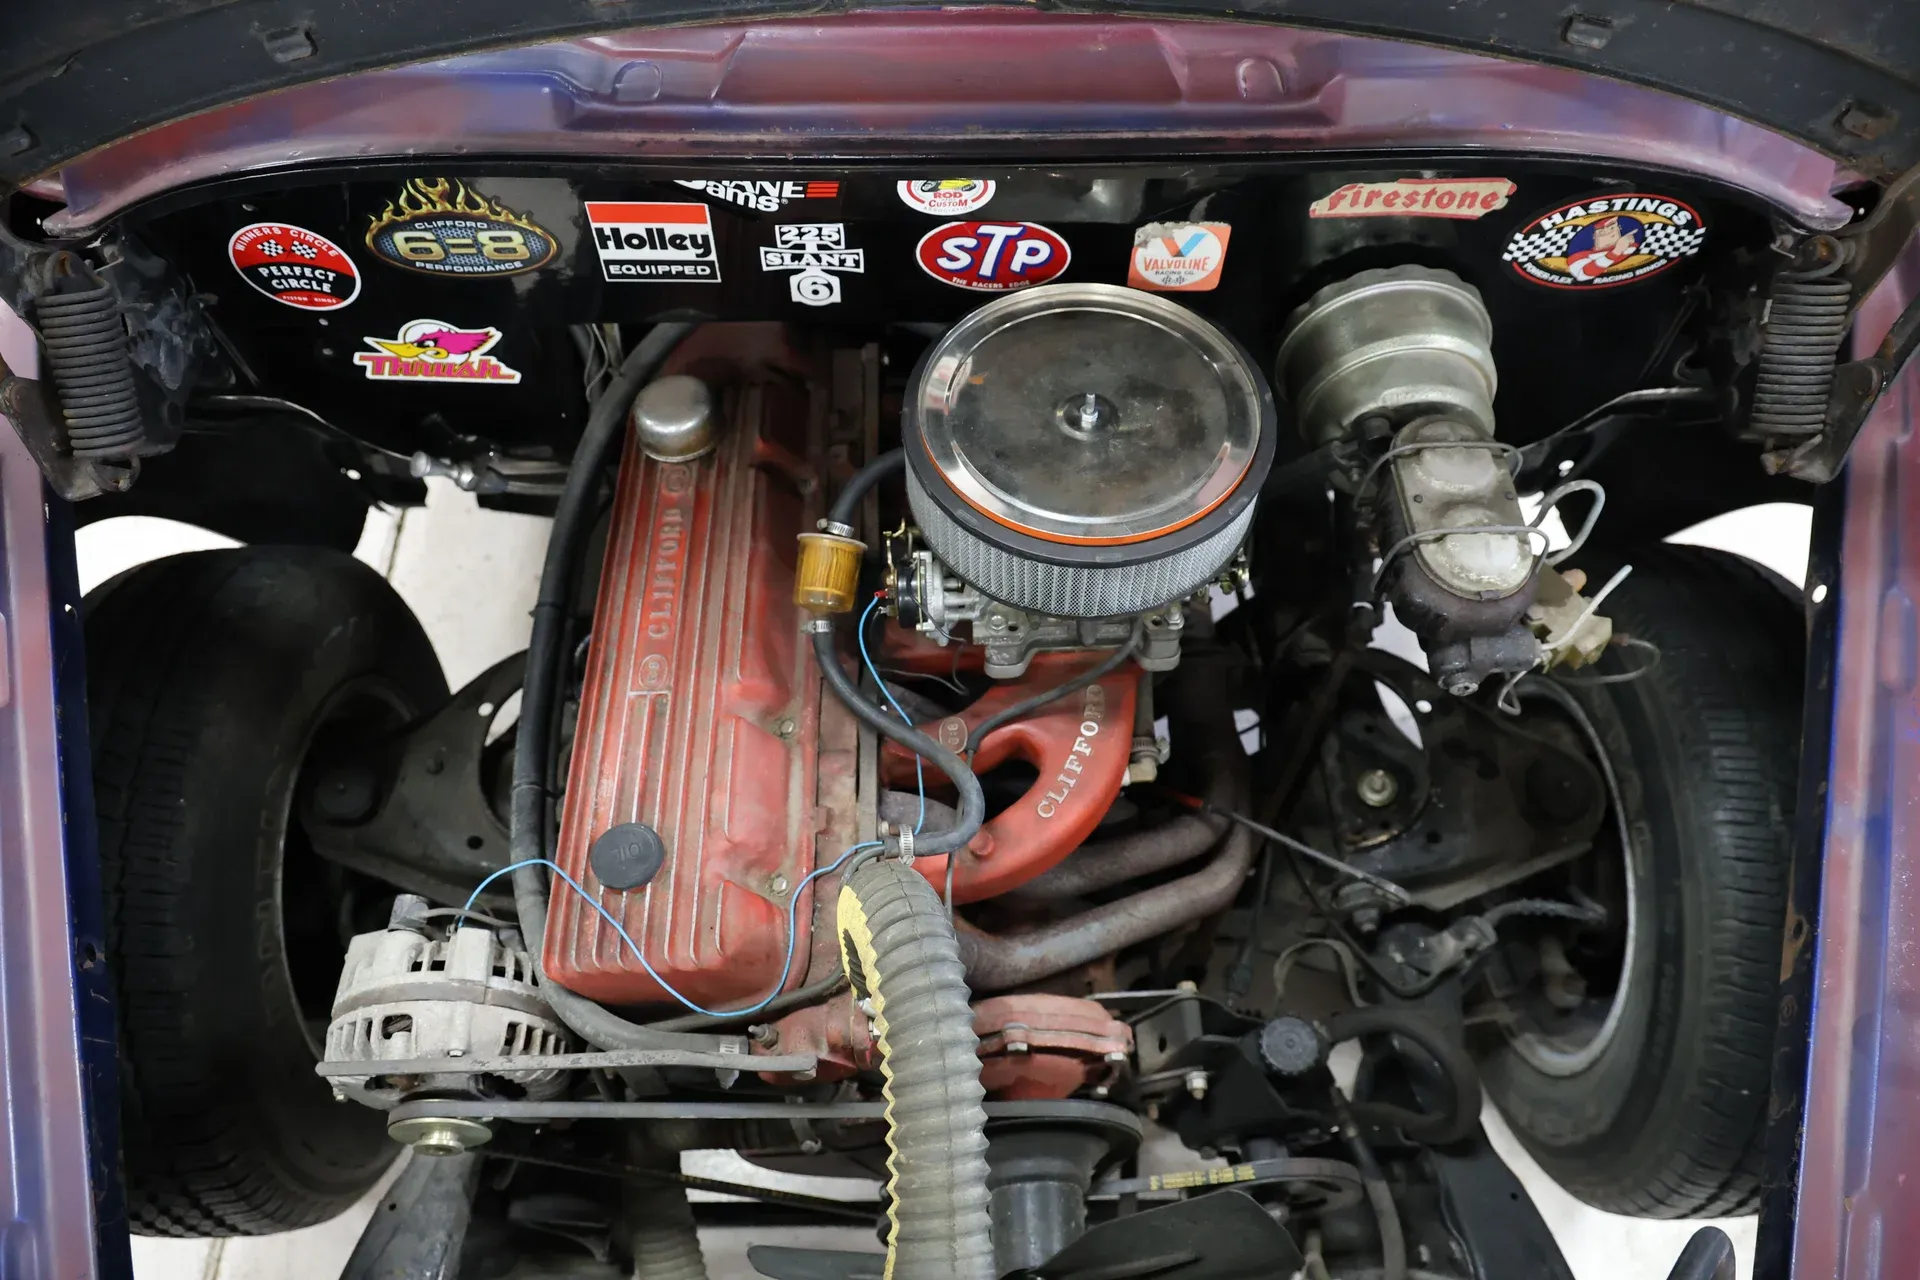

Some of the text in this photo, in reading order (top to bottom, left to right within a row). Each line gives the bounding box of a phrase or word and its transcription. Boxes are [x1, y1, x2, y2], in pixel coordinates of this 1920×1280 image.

[933, 191, 963, 199] ROD
[1328, 184, 1500, 211] Firestone
[1540, 198, 1692, 231] HASTINGS
[415, 220, 488, 229] CLIFFORD
[234, 226, 339, 257] WINNERS CIRCLE
[780, 226, 840, 241] 225
[594, 227, 712, 258] Holley
[936, 224, 1052, 278] STP
[415, 261, 523, 273] PERFORMANCE
[765, 252, 859, 267] SLANT
[1143, 256, 1208, 272] VALVOLINE
[258, 265, 336, 282] PERFECT
[608, 264, 711, 275] EQUIPPED
[271, 278, 331, 293] CIRCLE
[952, 277, 967, 286] THE
[972, 281, 1003, 289] RACERS
[1593, 272, 1634, 284] RACING
[799, 276, 832, 301] 6
[648, 509, 683, 638] CLIFFORD
[610, 843, 641, 861] OIL
